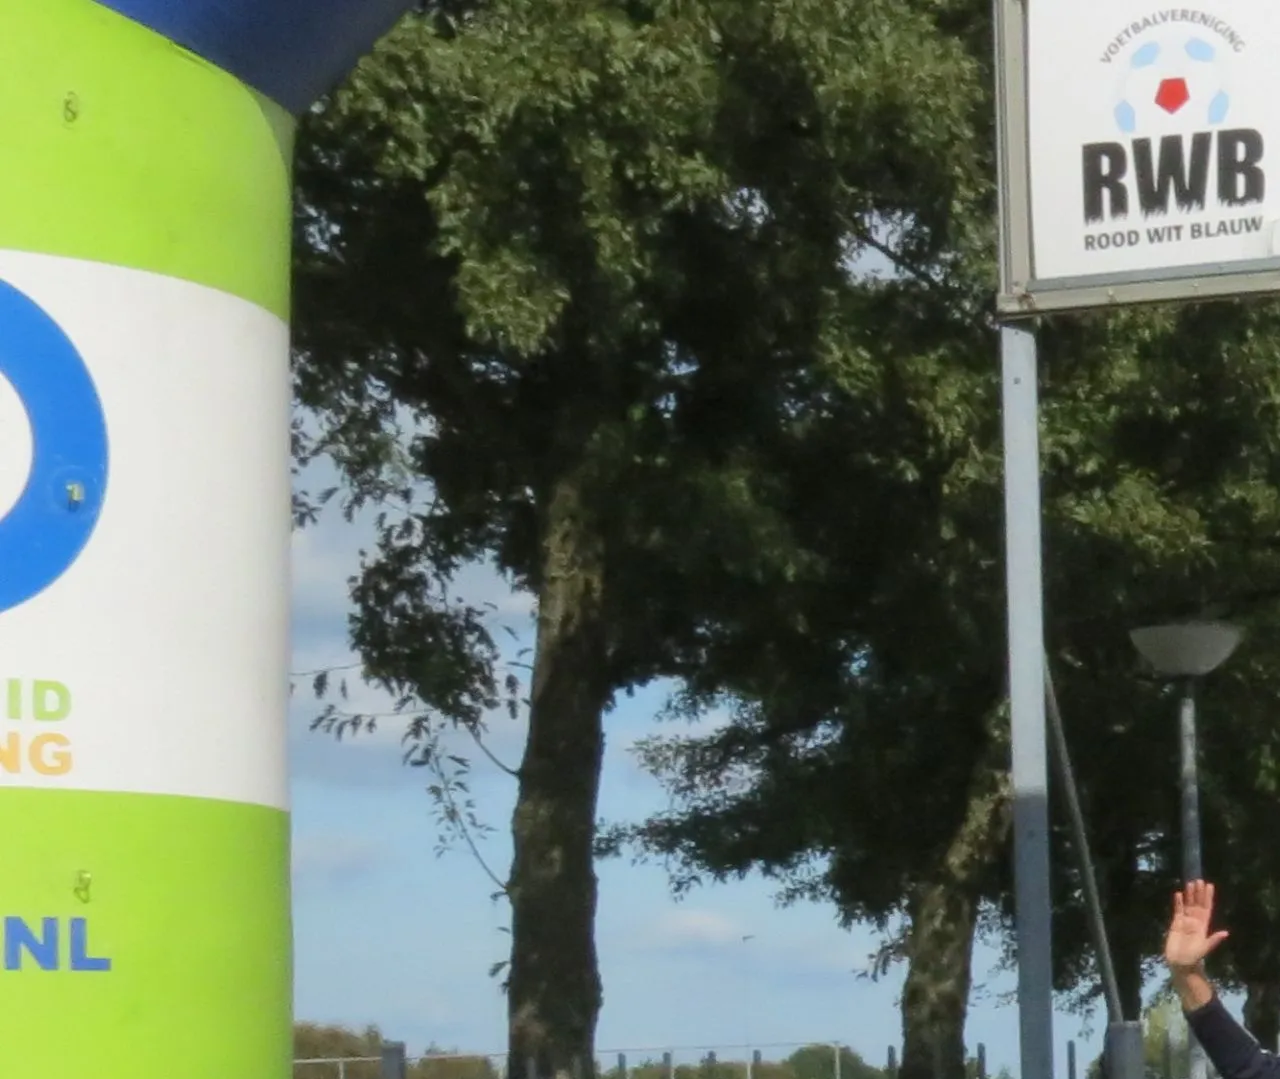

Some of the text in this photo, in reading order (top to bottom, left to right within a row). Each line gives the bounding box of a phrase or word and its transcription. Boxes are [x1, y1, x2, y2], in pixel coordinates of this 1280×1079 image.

[1099, 9, 1245, 64] VOETBALVERENIGING
[1082, 128, 1265, 226] RWB
[1084, 216, 1263, 252] ROOD WIT BLAUW
[7, 677, 72, 721] ID
[4, 916, 112, 972] NL
